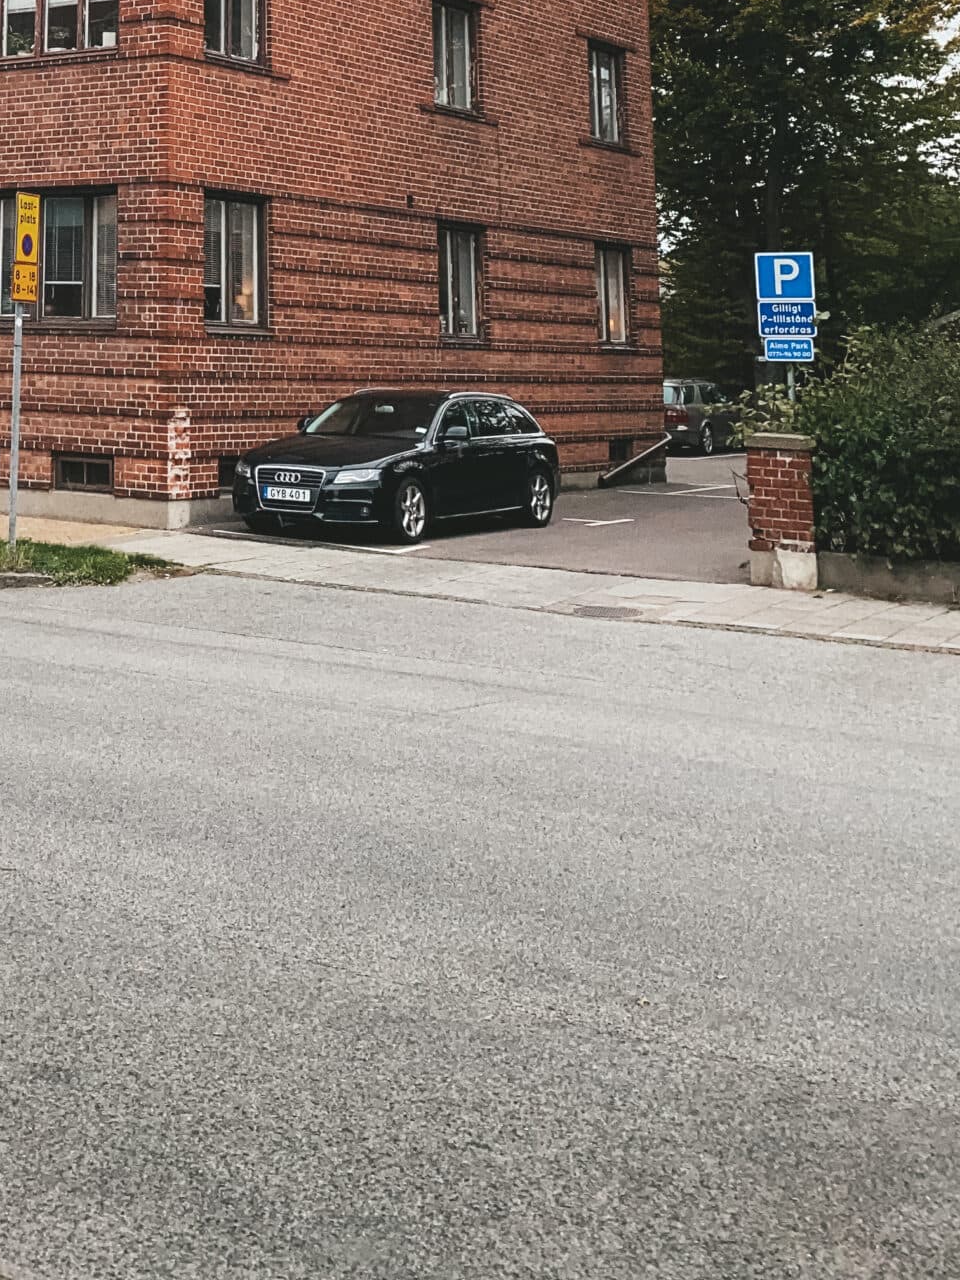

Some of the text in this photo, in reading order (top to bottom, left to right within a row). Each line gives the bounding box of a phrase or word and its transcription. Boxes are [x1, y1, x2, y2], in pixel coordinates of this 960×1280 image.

[15, 269, 21, 280] 8
[773, 258, 800, 295] P
[771, 304, 802, 314] Giltigt
[764, 325, 812, 334] erfordras
[791, 341, 809, 350] Park
[271, 489, 306, 500] GYB 401
